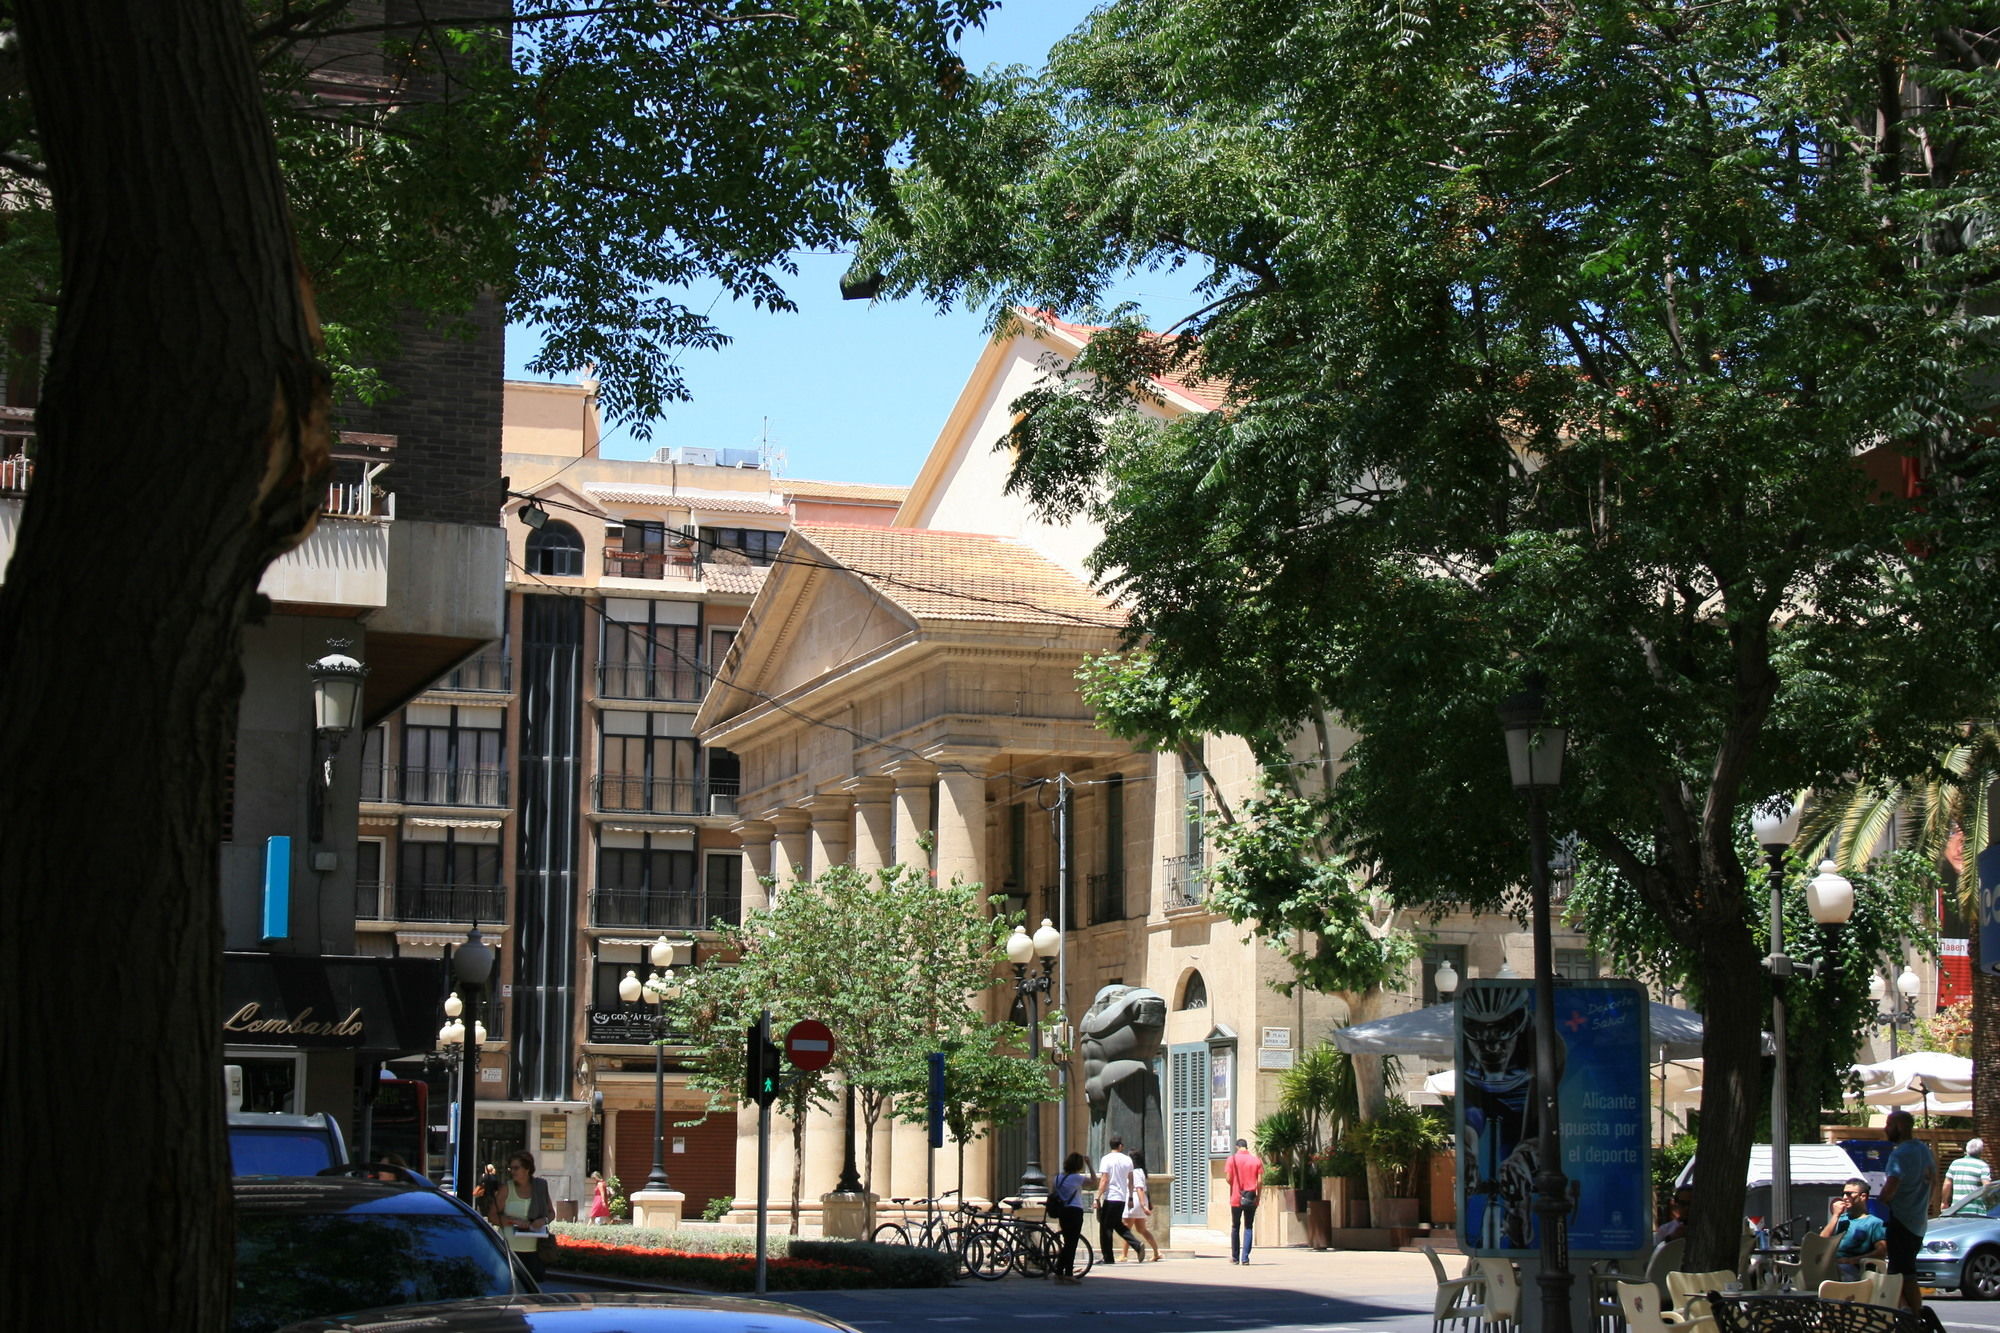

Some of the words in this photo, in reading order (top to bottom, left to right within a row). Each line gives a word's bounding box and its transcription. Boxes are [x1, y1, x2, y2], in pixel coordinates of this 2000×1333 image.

[222, 1001, 364, 1036] Lombardo
[1592, 1012, 1626, 1030] Salud
[1583, 1091, 1636, 1109] Alicante
[1615, 1123, 1637, 1139] por
[1569, 1146, 1580, 1162] el
[1585, 1146, 1637, 1166] deporte
